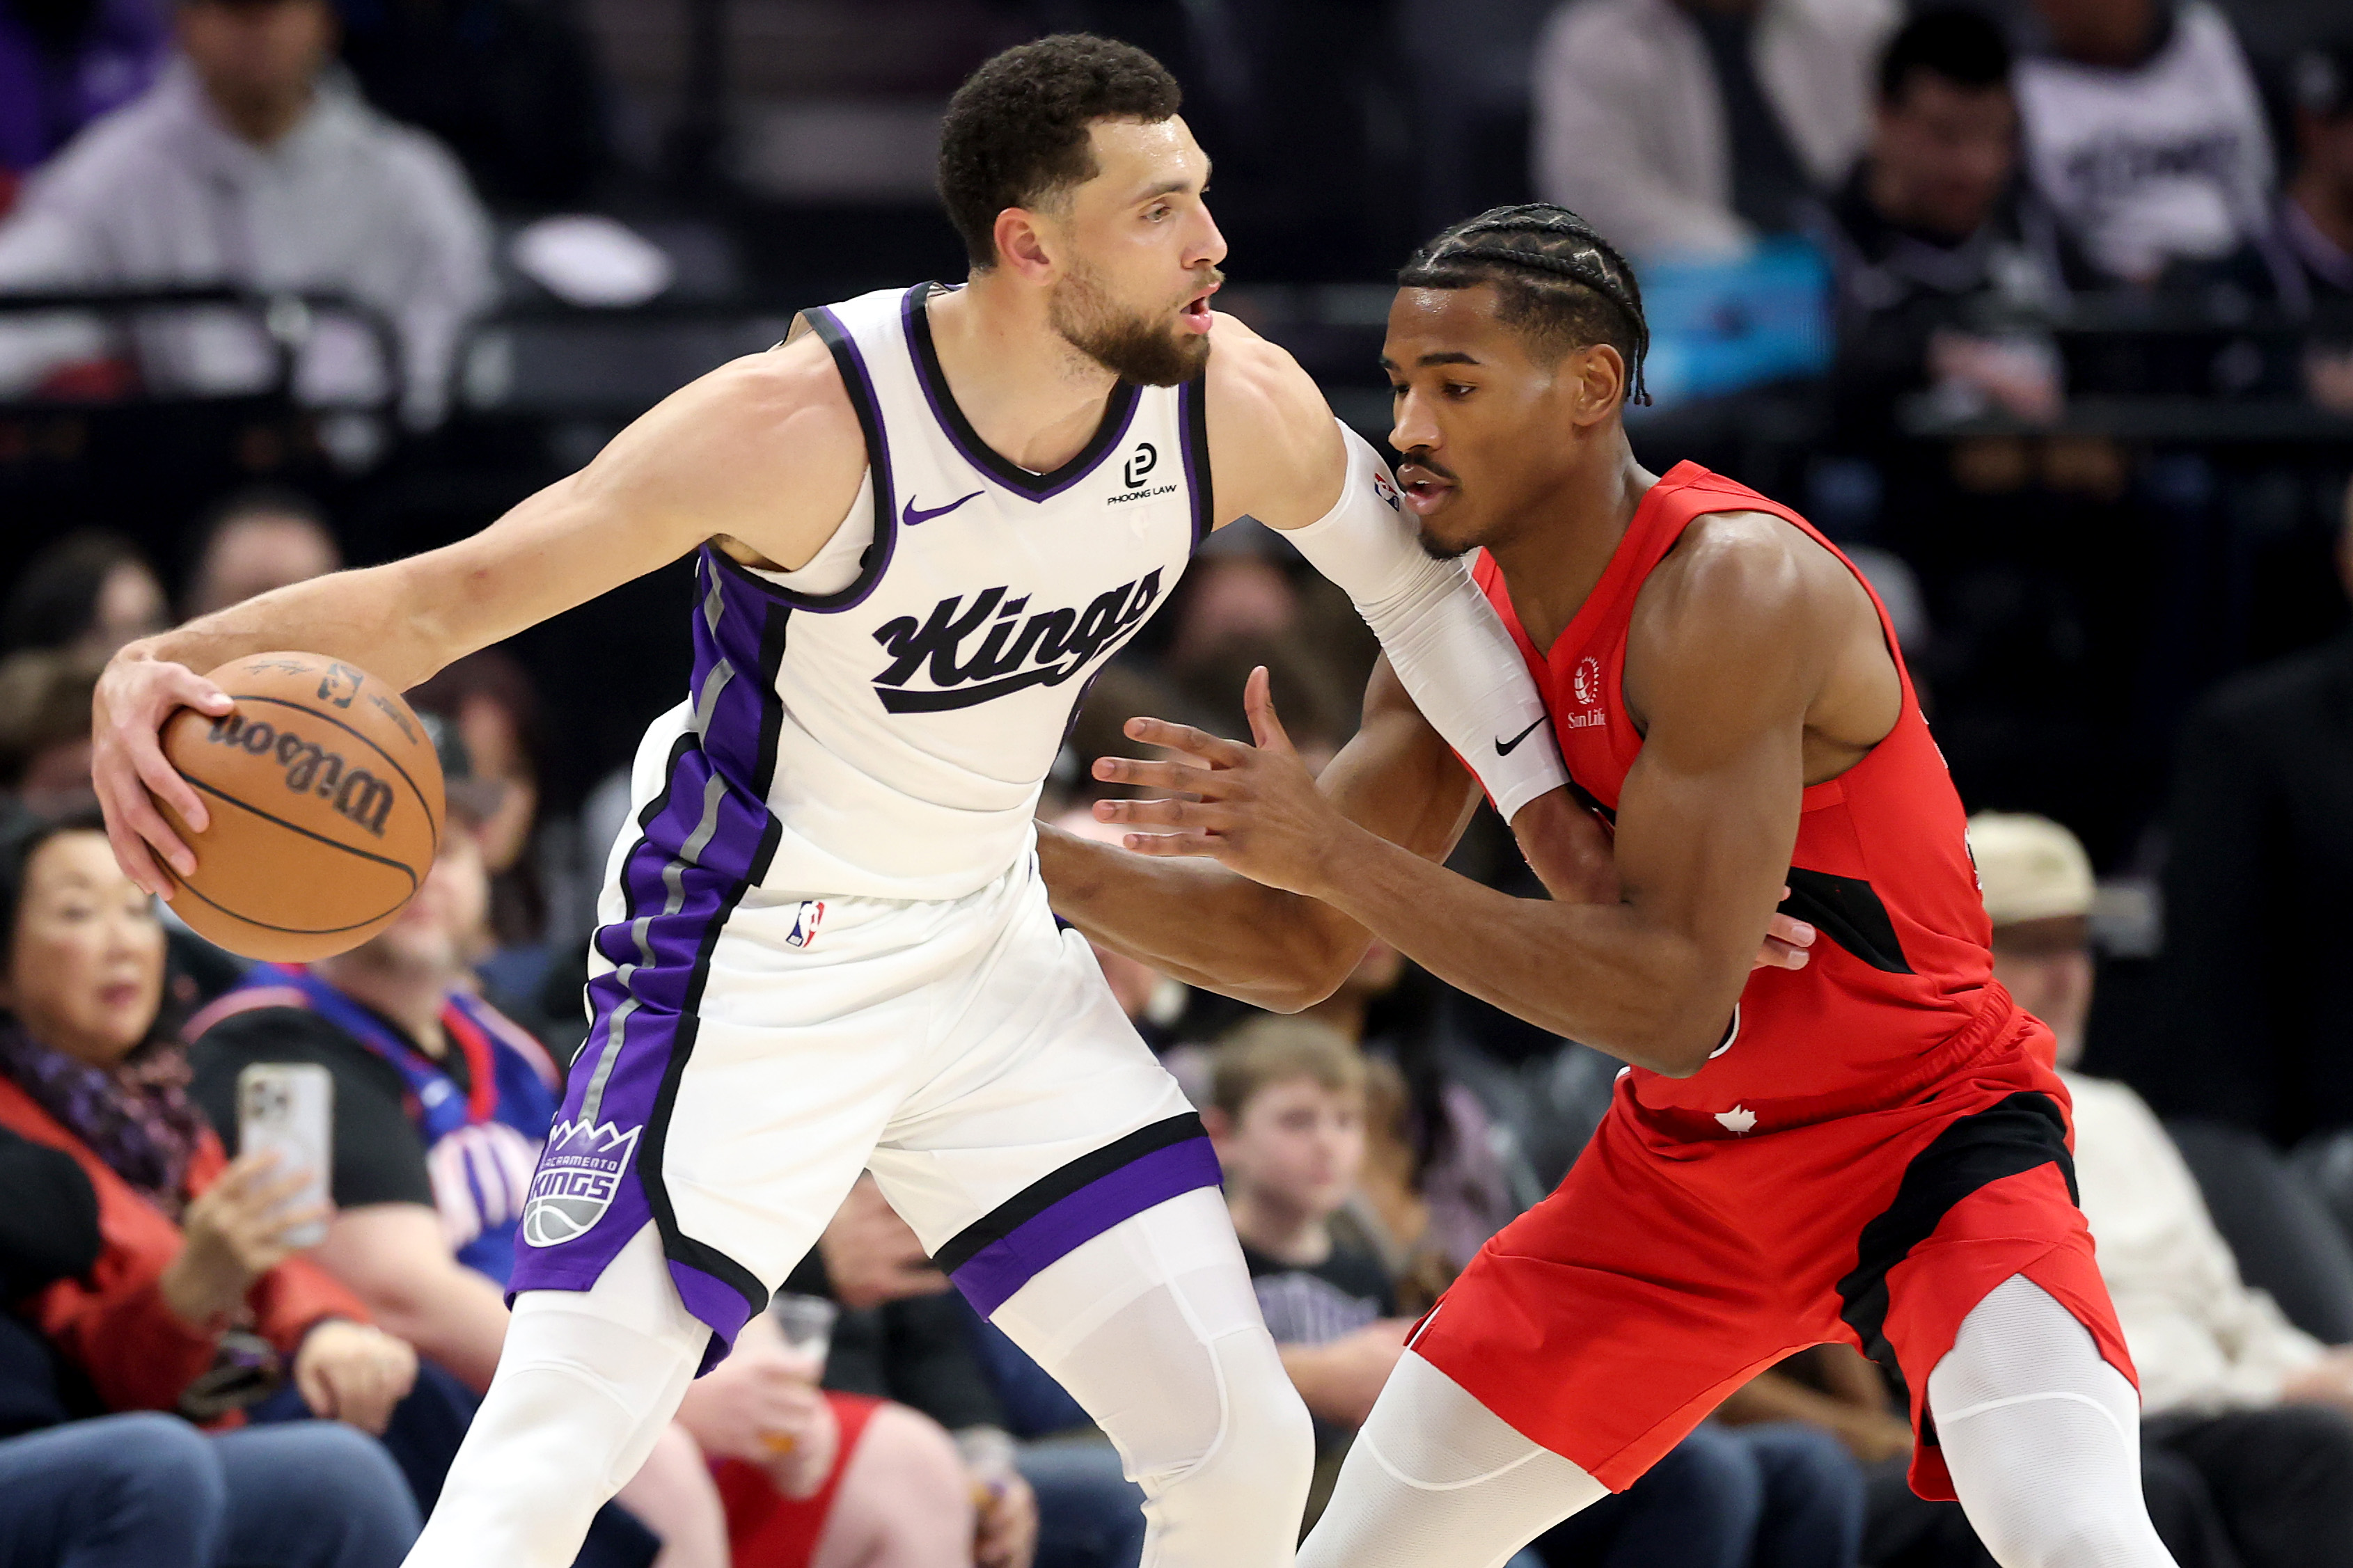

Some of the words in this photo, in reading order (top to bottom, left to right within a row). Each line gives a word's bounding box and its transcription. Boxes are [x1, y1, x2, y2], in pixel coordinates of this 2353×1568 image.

[1107, 489, 1151, 506] PHOONG
[1153, 484, 1177, 495] LAW
[870, 564, 1165, 715] Kings
[207, 715, 394, 839] Wilson
[530, 1171, 615, 1201] KINGS
